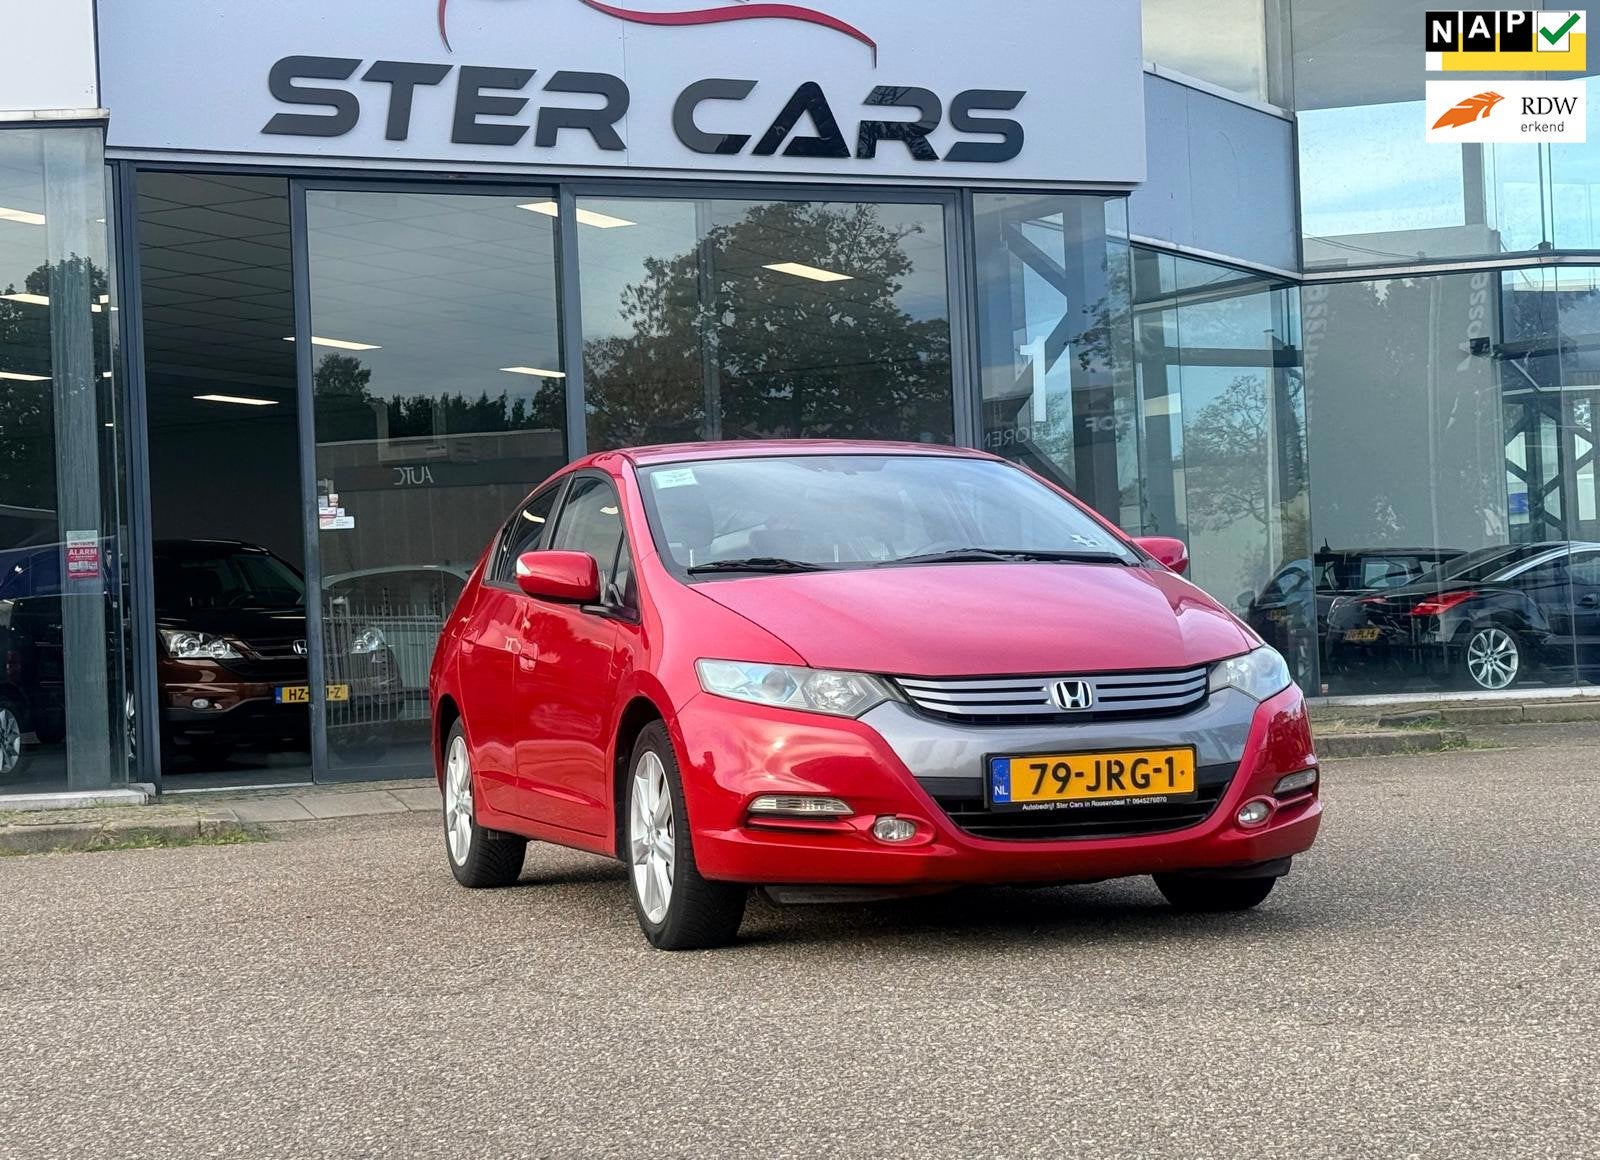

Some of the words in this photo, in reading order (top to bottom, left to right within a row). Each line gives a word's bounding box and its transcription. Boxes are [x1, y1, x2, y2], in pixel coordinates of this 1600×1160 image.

[260, 55, 631, 151] STER
[672, 78, 1027, 163] CARS
[69, 548, 97, 556] ALARM
[1030, 757, 1175, 795] 79-JRG-1
[995, 785, 1008, 796] NL
